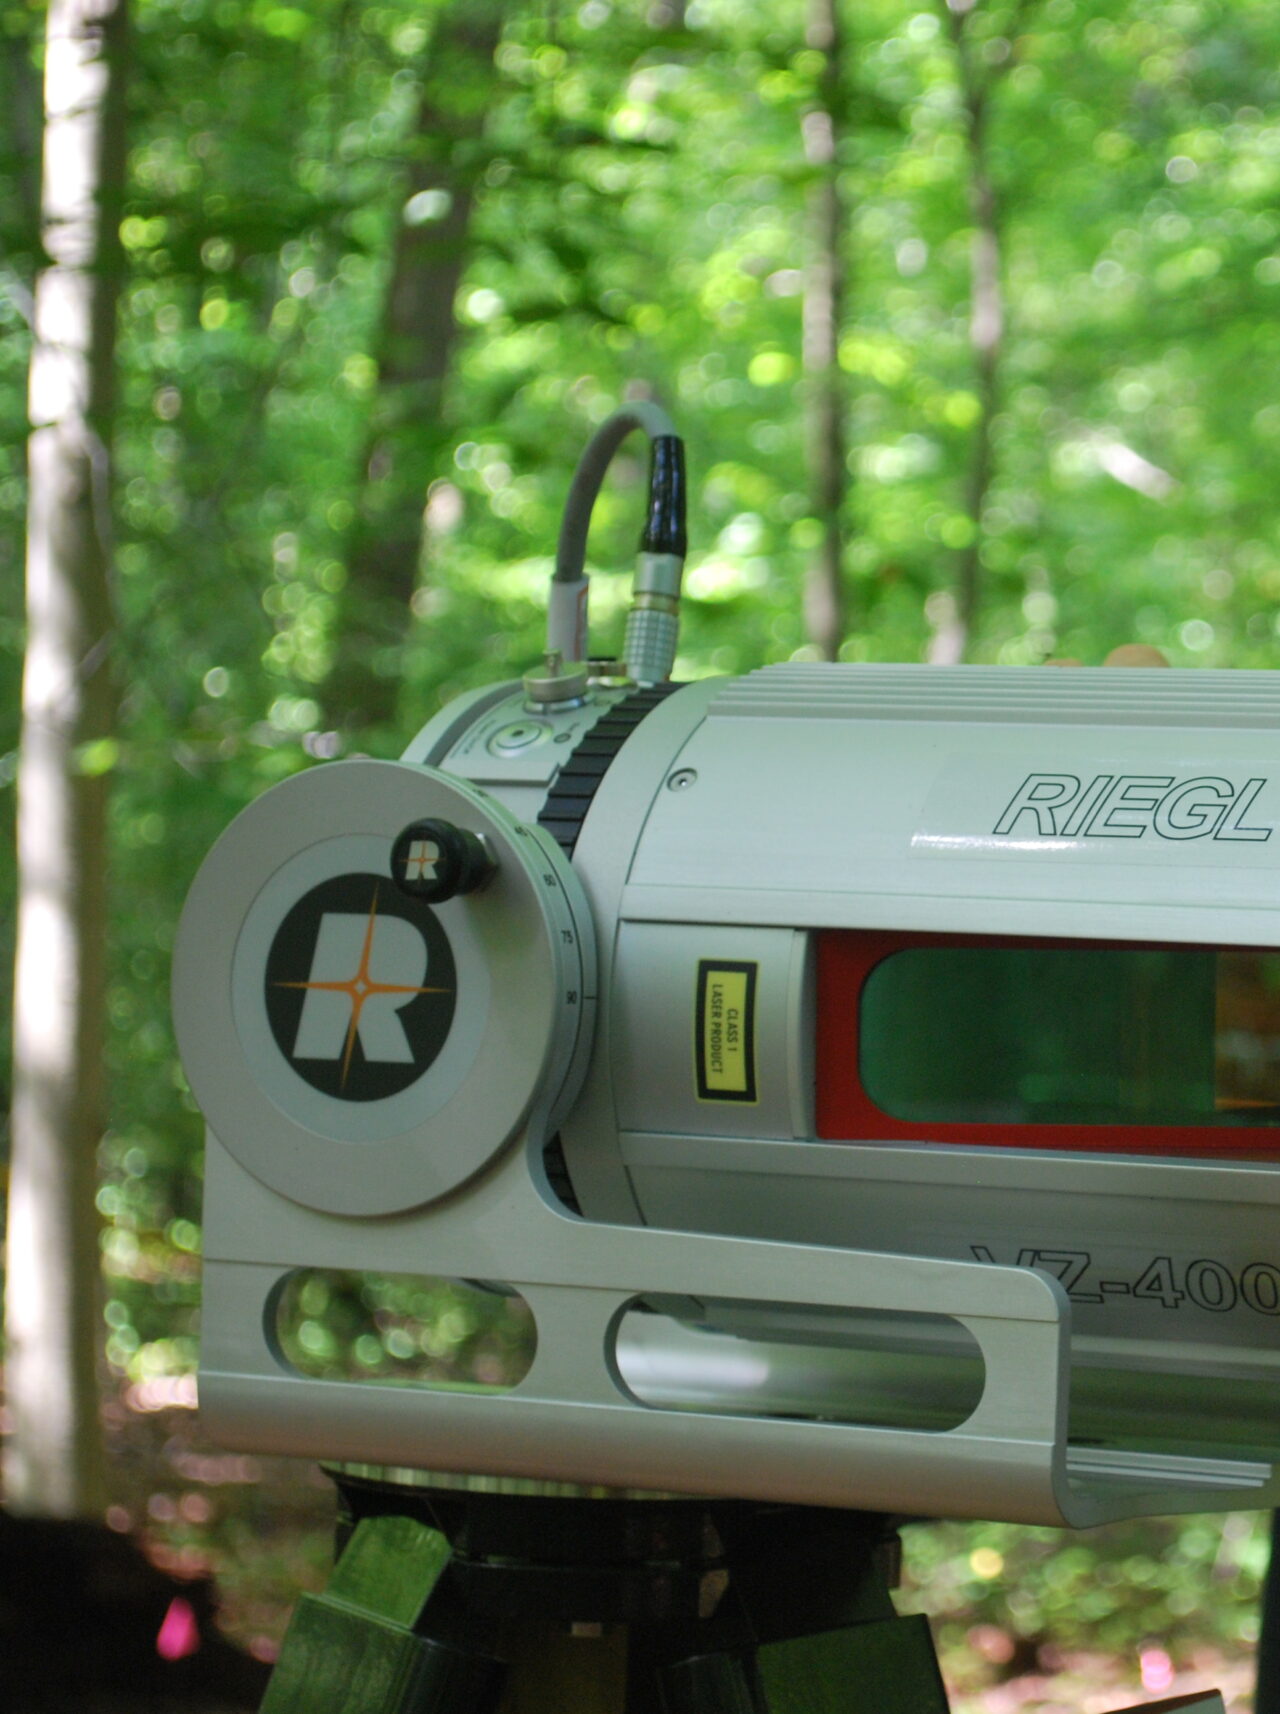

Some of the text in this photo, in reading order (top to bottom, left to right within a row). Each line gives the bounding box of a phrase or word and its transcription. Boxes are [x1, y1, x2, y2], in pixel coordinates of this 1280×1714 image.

[992, 773, 1274, 842] RIEGL
[404, 840, 440, 880] R
[561, 929, 573, 945] 75
[292, 911, 429, 1065] R
[711, 983, 724, 1074] LASER PRODUCT
[727, 1007, 738, 1044] CLASS
